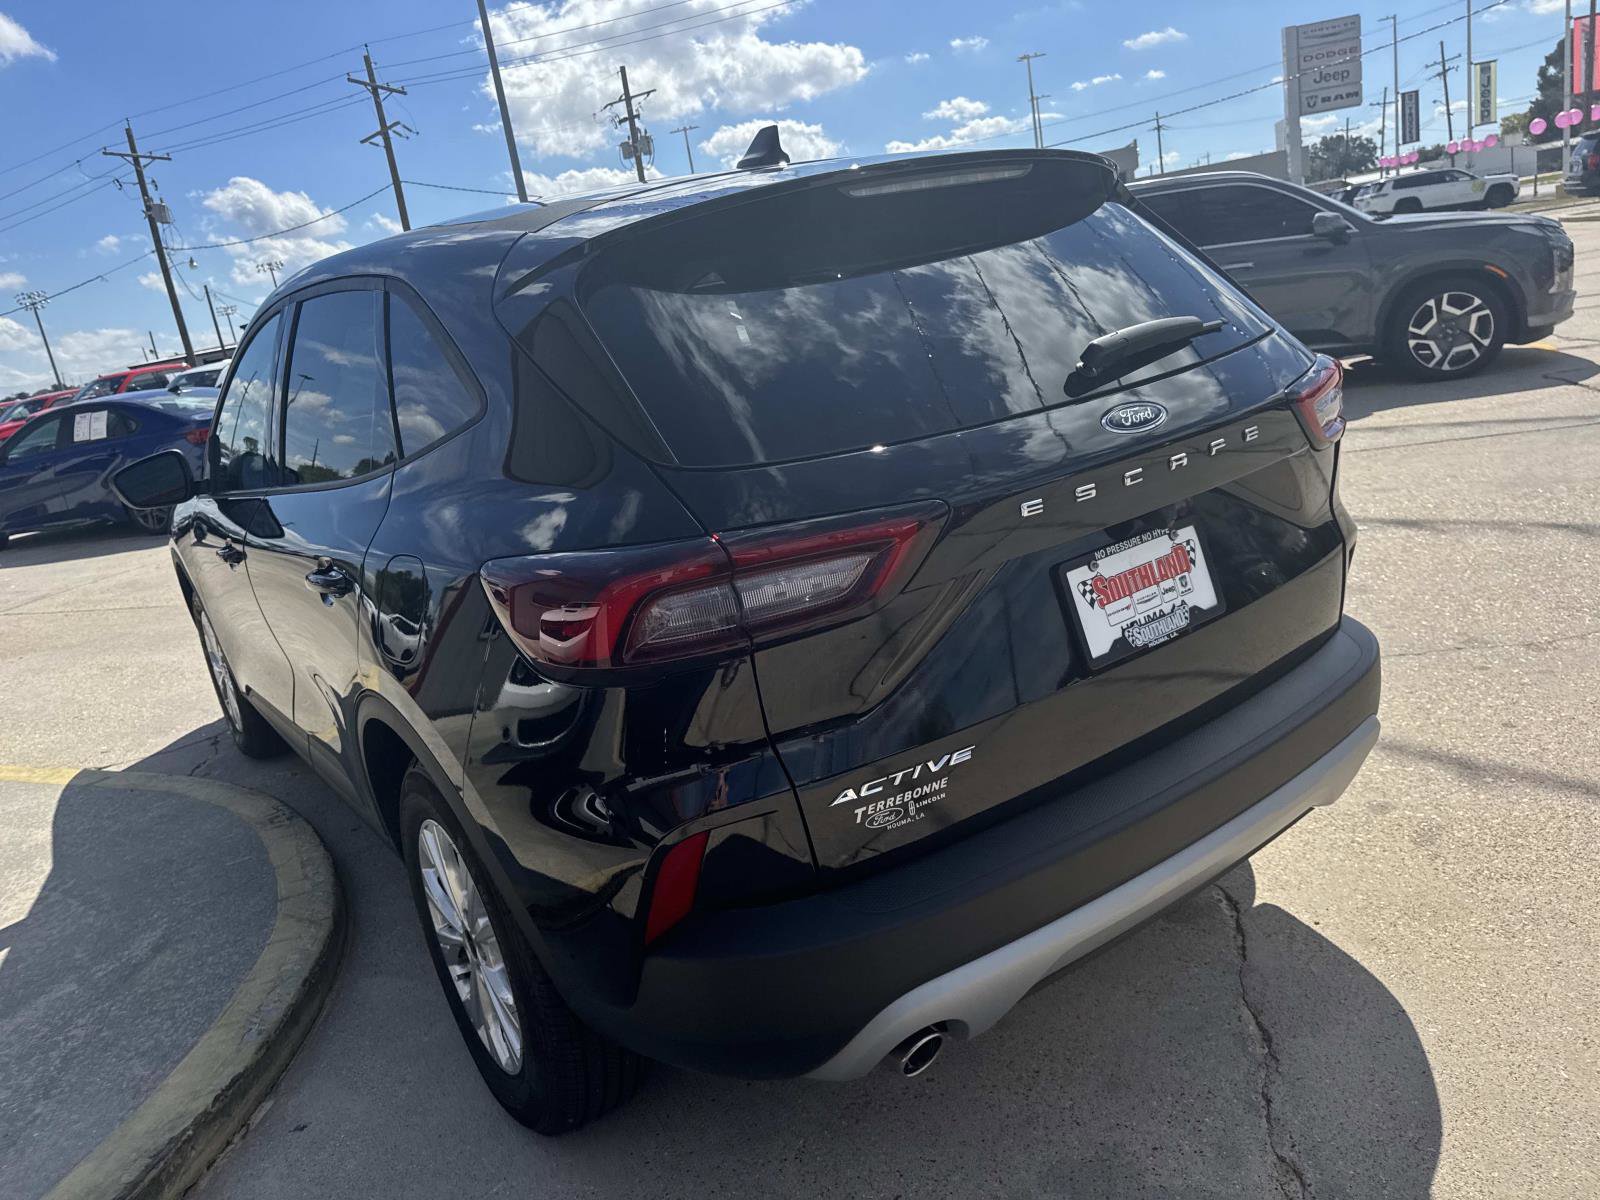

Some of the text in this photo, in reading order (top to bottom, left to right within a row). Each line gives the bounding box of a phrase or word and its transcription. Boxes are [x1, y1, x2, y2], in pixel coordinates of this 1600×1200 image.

[1303, 46, 1358, 62] DODGE
[1313, 69, 1350, 84] Jeep
[1321, 91, 1359, 103] RAM
[1119, 406, 1155, 426] Ford
[1021, 425, 1259, 517] ESCAPE
[1094, 528, 1170, 560] NO PRESSURE NO HYPE
[1092, 545, 1192, 609] SOUTHLAND
[1132, 608, 1187, 647] SOUTHLAND
[828, 745, 976, 808] ACTIVE
[854, 777, 949, 824] TERREBONNE
[873, 792, 947, 826] Ford LINCOLN
[887, 812, 926, 830] HOUMA, LA
